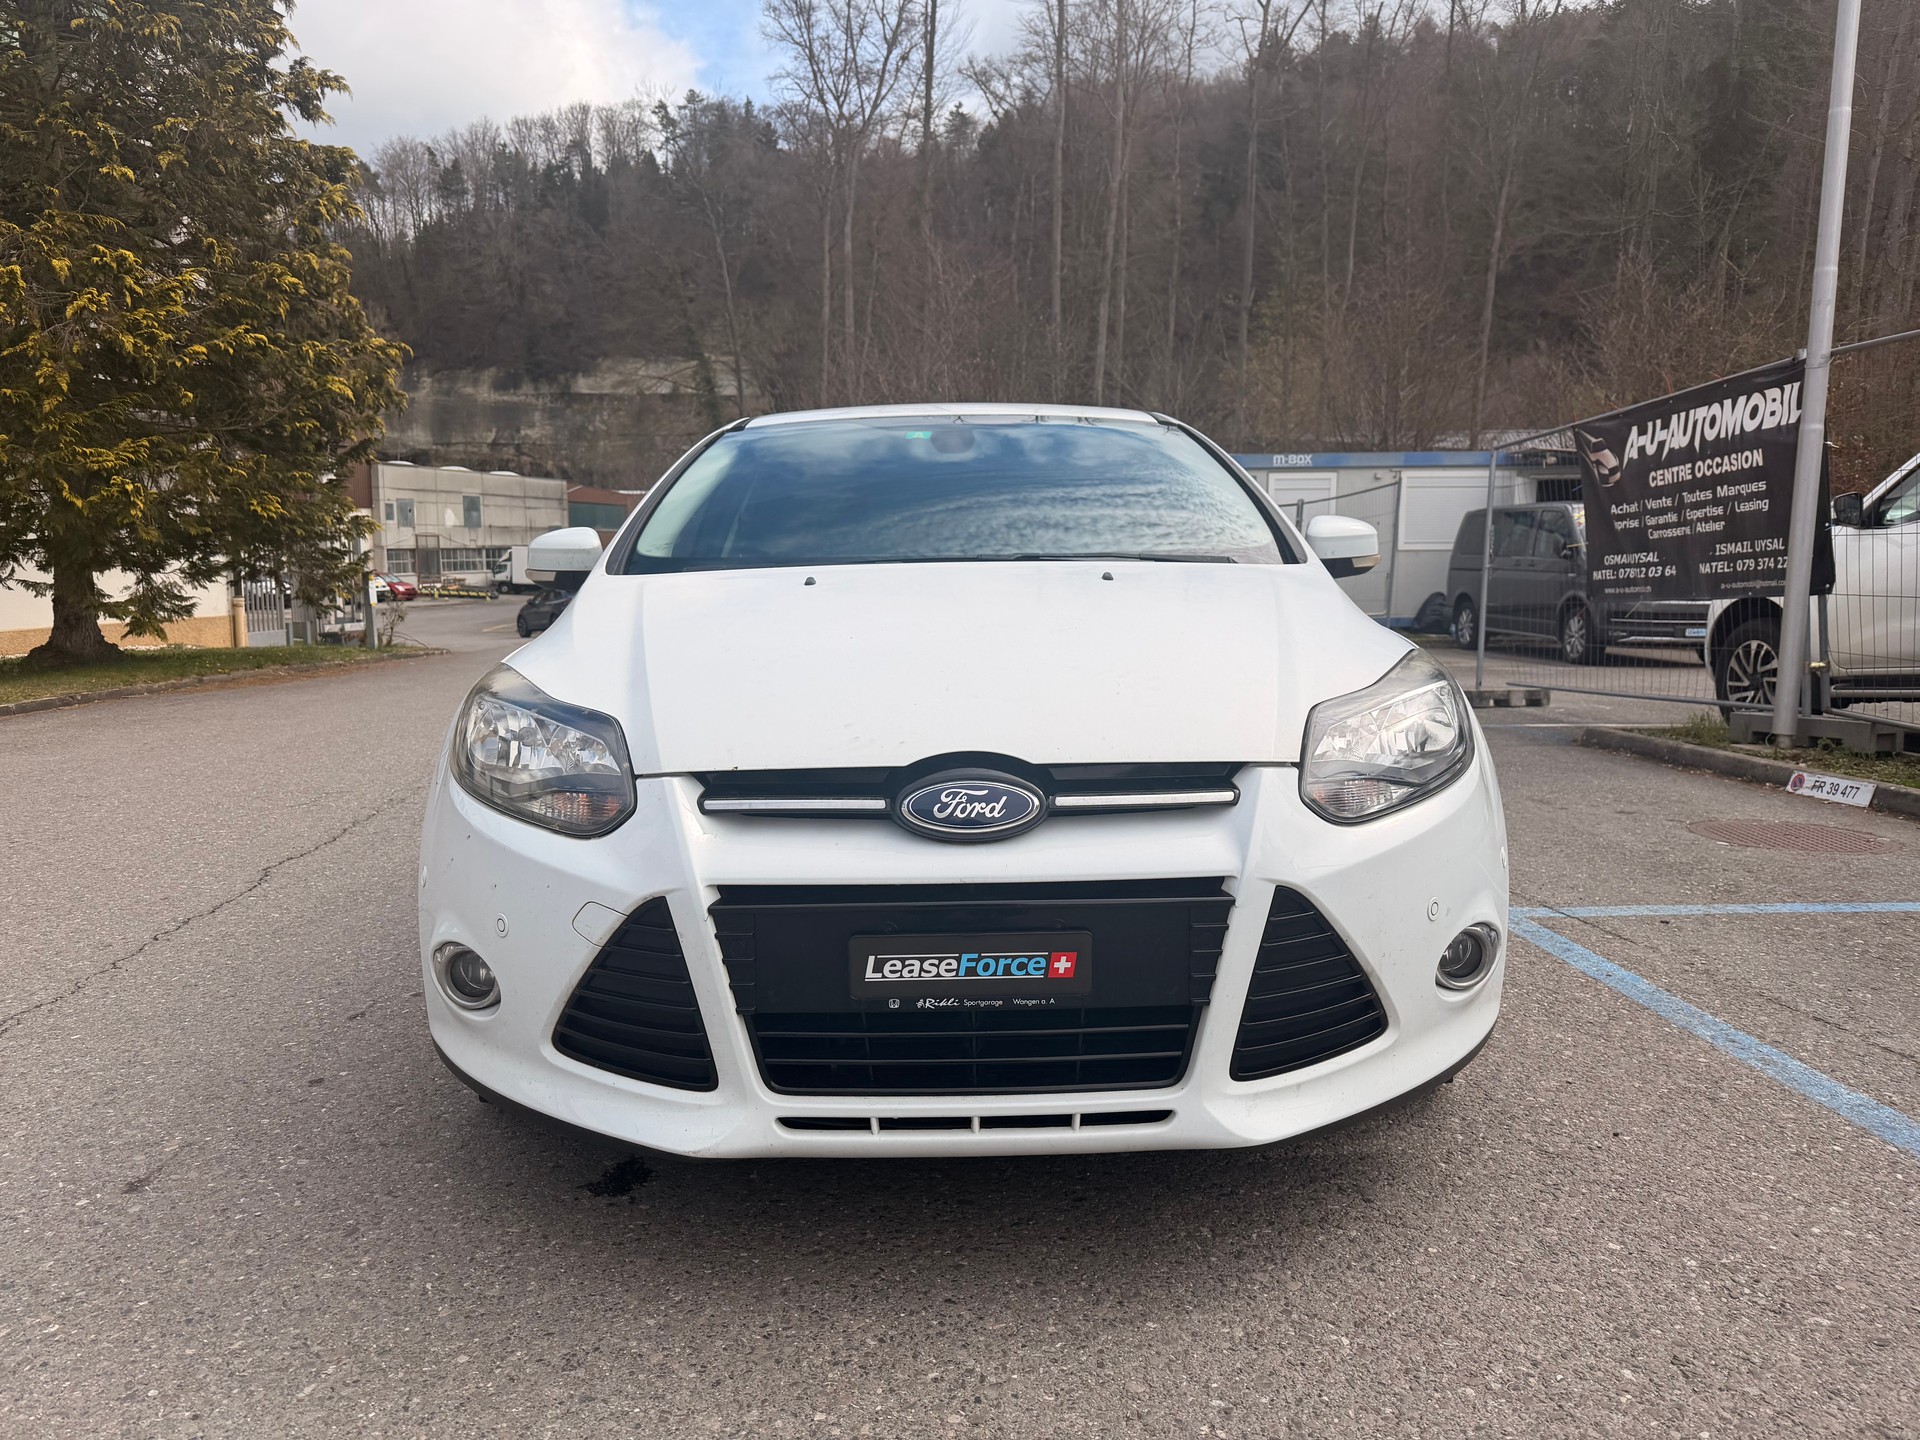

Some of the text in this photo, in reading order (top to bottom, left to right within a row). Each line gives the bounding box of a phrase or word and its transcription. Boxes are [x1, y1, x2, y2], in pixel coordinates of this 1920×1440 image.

[1649, 448, 1763, 487] CENTRE OCCASION
[1611, 503, 1639, 515] Achat
[1645, 496, 1673, 510] Vente
[1682, 489, 1713, 504] Toutes
[1716, 481, 1767, 498] Marques
[1645, 512, 1679, 526] Garantie
[1686, 505, 1724, 521] Expertise
[1735, 497, 1769, 513] Leasing
[1696, 520, 1726, 533] Atelier
[1715, 538, 1785, 555] ISMAIL UYSAL
[1592, 569, 1617, 580] NATEL:
[1648, 566, 1663, 577] 03
[1665, 565, 1677, 576] 64
[1699, 561, 1733, 574] NATEL:
[1736, 559, 1755, 571] 079
[1757, 557, 1774, 570] 374
[1811, 780, 1861, 800] FR 39 477
[933, 788, 1007, 819] Ford
[865, 954, 1046, 978] LeaseForce
[963, 999, 1003, 1008] Sportgarage
[1012, 998, 1040, 1006] Wangen
